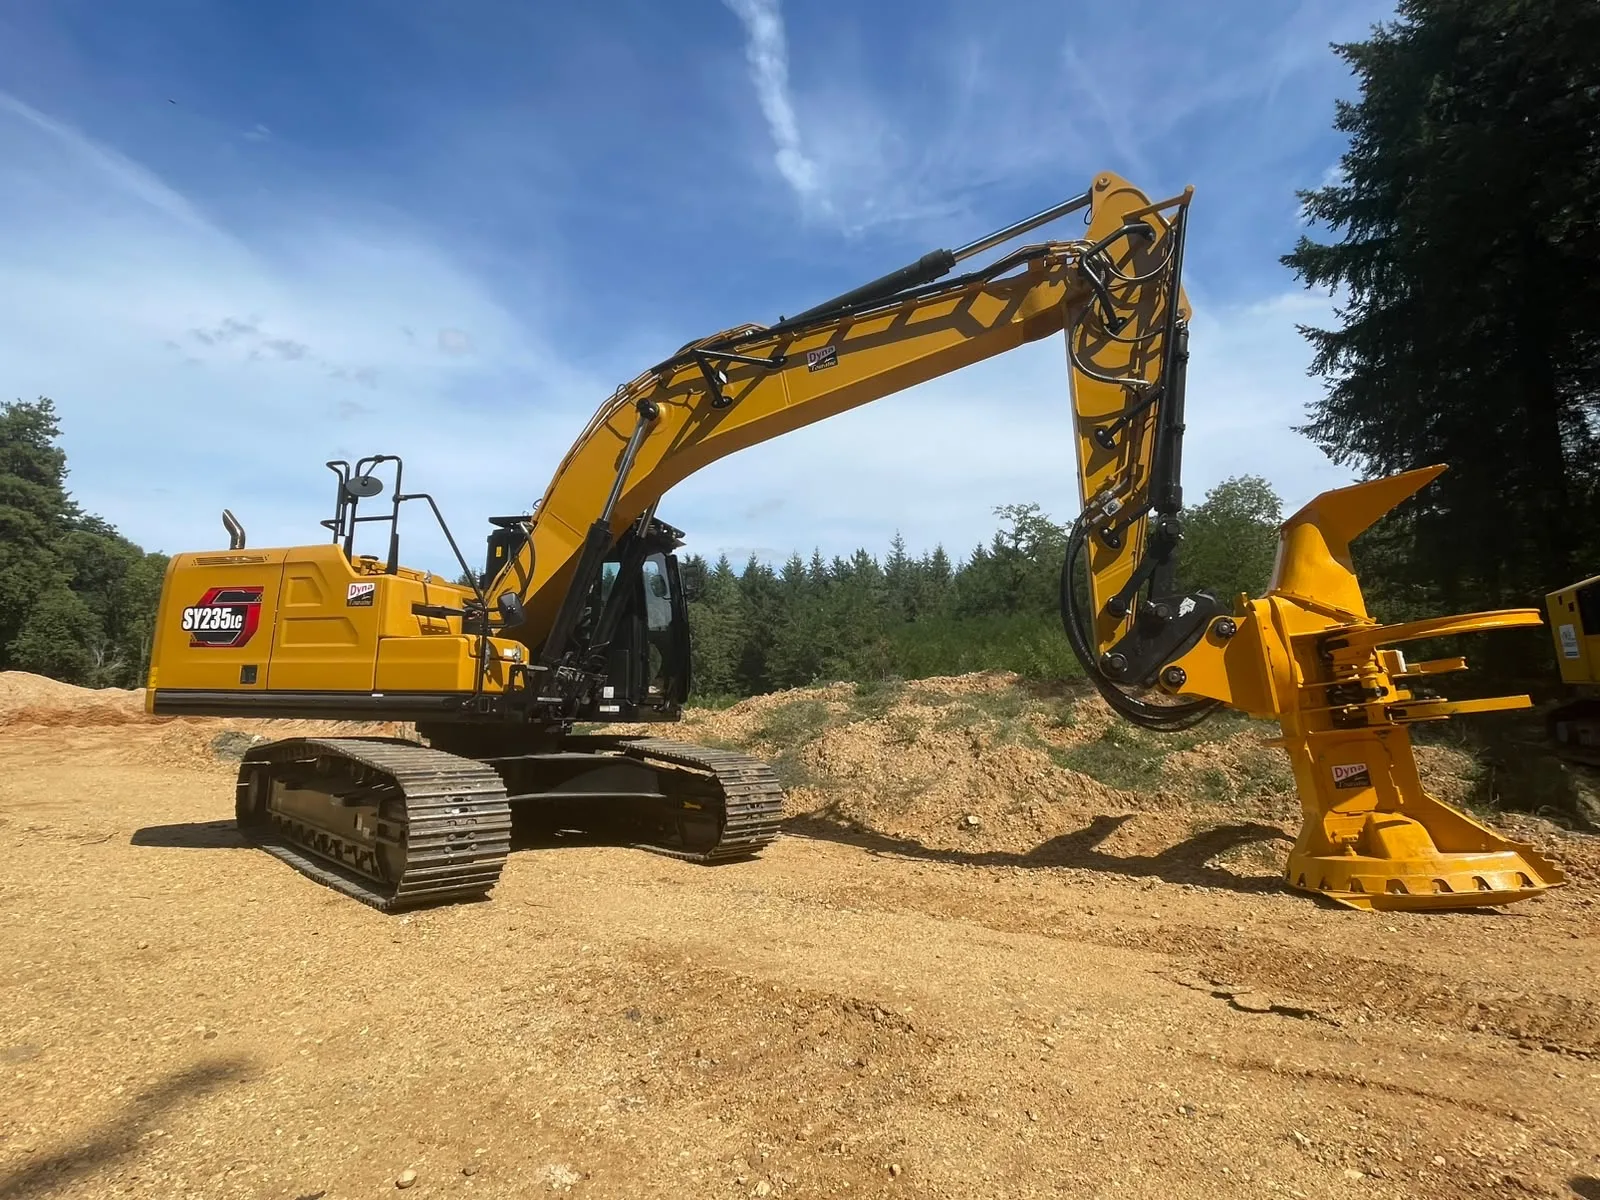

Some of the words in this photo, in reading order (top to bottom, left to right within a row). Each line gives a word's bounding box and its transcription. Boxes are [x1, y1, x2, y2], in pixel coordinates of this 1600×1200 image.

[809, 346, 834, 363] Dyna
[350, 584, 374, 596] Dyna
[182, 607, 243, 630] SY235LC
[1334, 764, 1365, 779] Dyna
